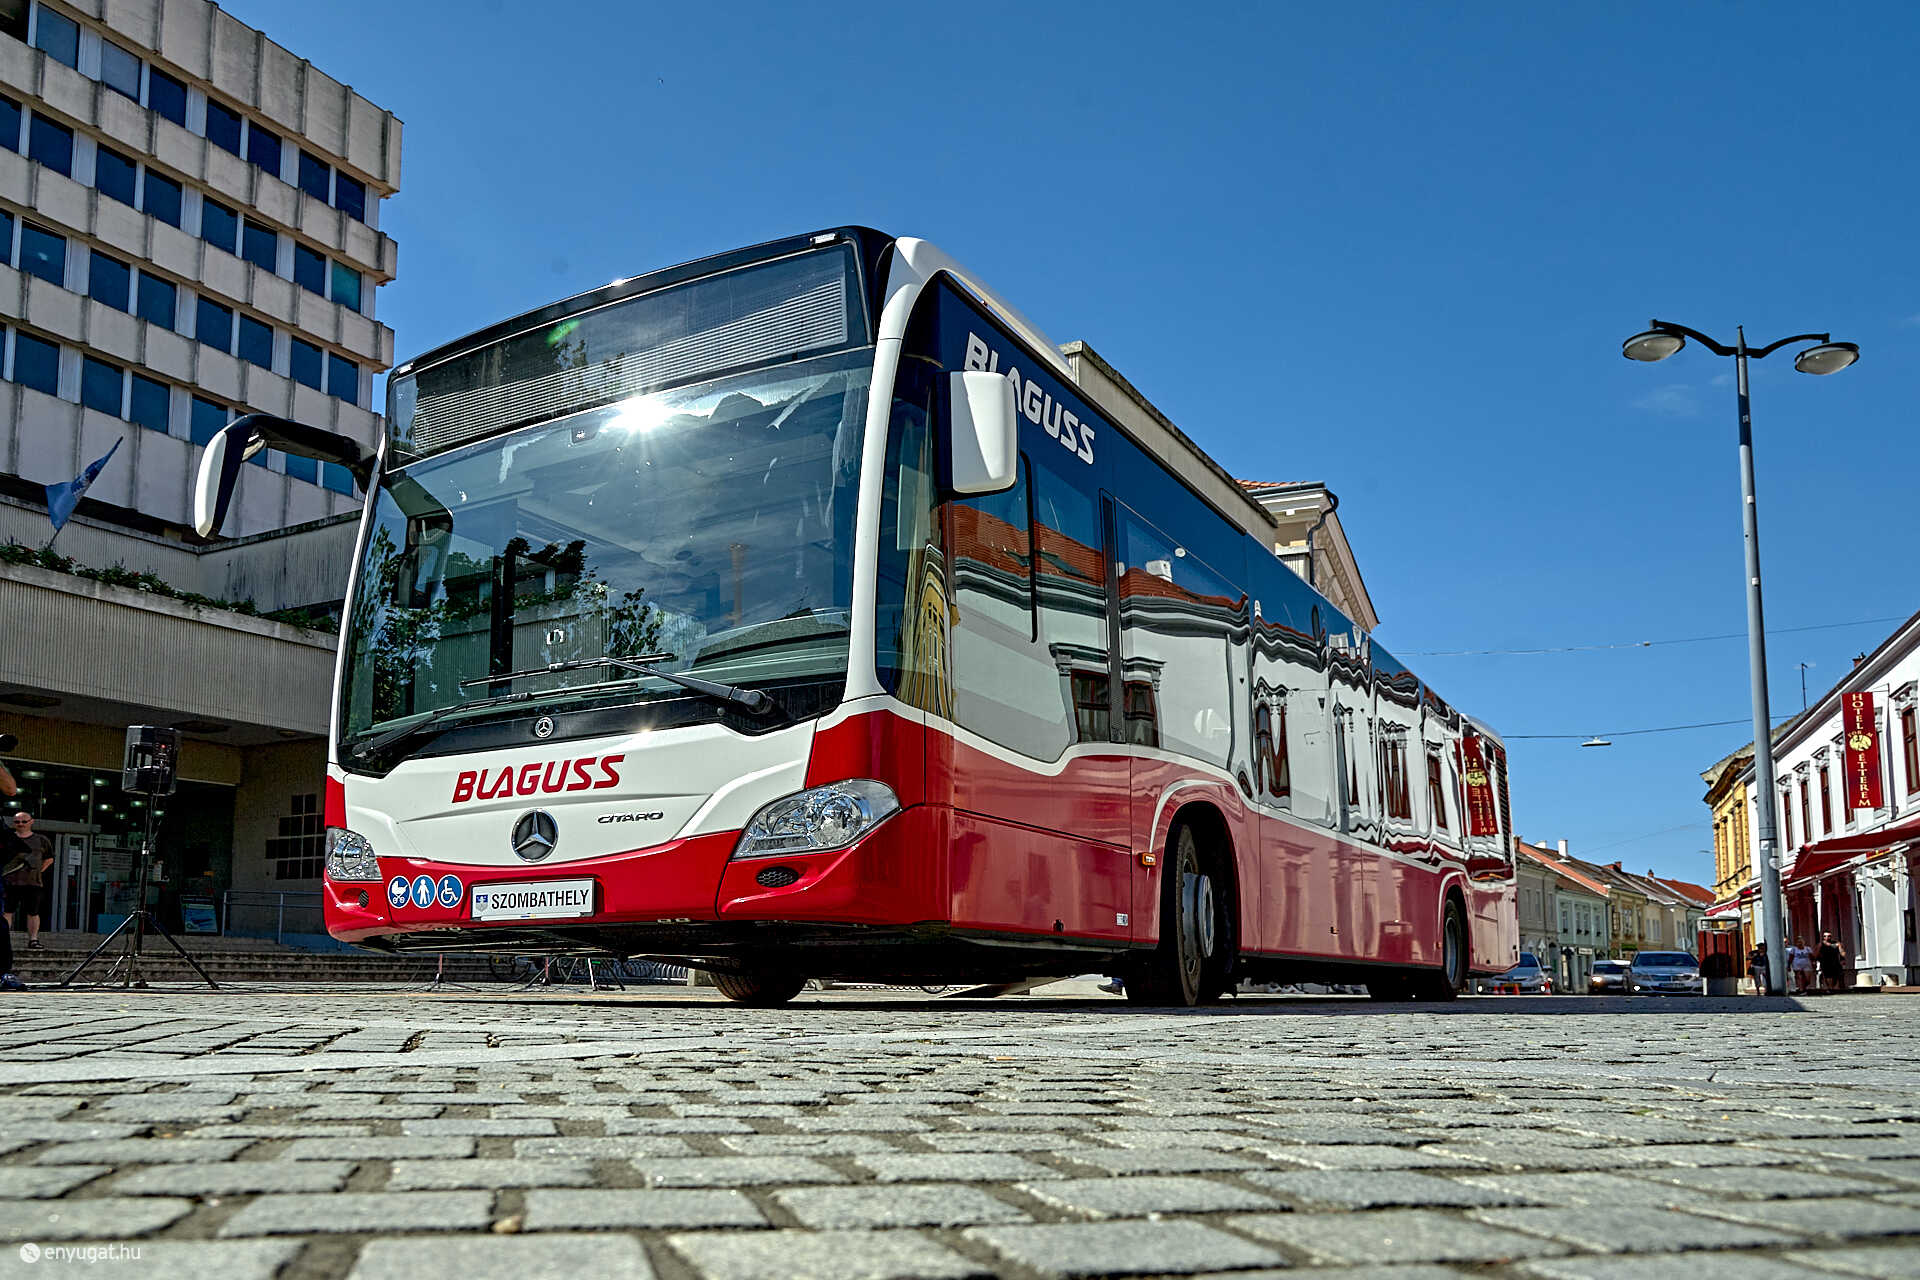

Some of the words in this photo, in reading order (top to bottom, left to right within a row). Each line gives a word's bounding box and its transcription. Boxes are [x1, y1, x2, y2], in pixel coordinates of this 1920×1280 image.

[1852, 693, 1864, 730] HOTEL
[451, 754, 626, 804] BLAGUSS
[597, 811, 664, 824] CITARO
[491, 888, 590, 910] SZOMBATHELY
